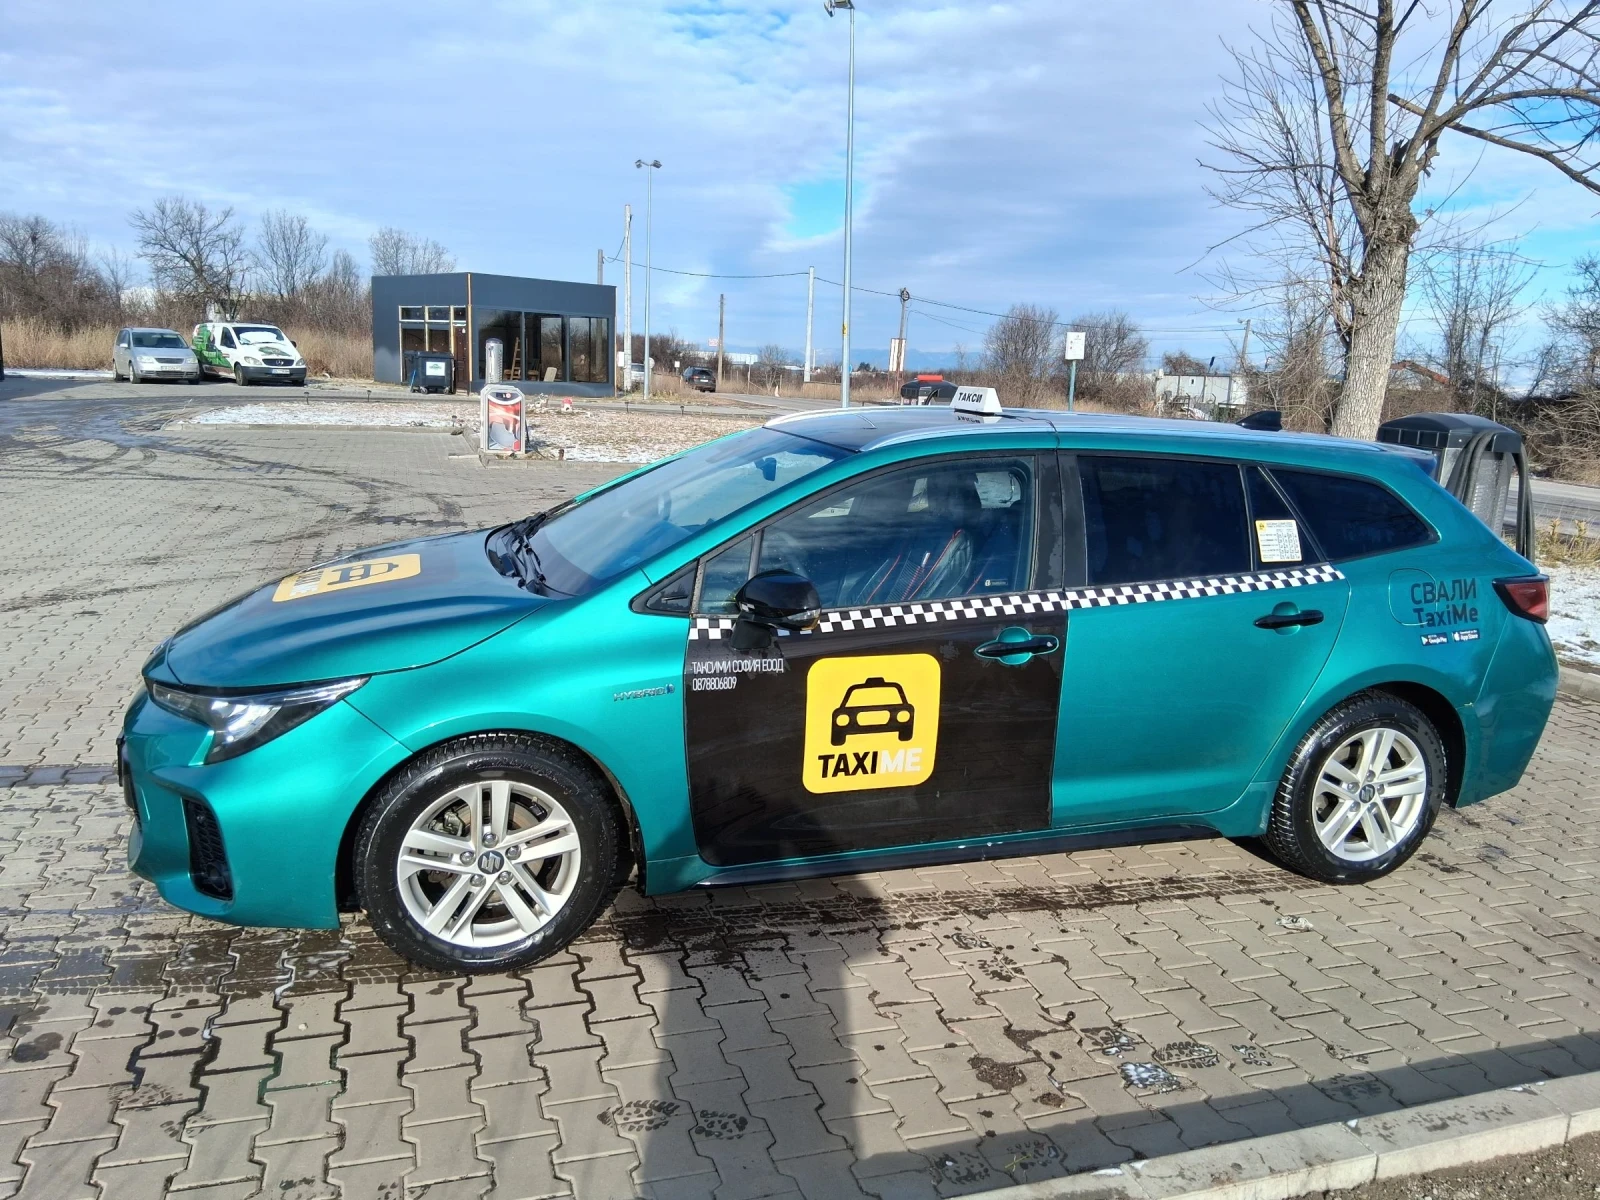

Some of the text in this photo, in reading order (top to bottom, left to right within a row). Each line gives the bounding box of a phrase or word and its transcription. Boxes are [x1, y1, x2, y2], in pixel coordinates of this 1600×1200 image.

[958, 392, 983, 403] ТАКСИ
[1411, 578, 1476, 604] СВАЛИ
[1413, 603, 1478, 628] TaxiMe
[691, 658, 784, 675] ТАКСИМИ СОФИЯ ЕООД
[692, 676, 737, 691] 0878806809
[614, 687, 667, 702] HYBRID
[817, 747, 922, 779] TAXIME
